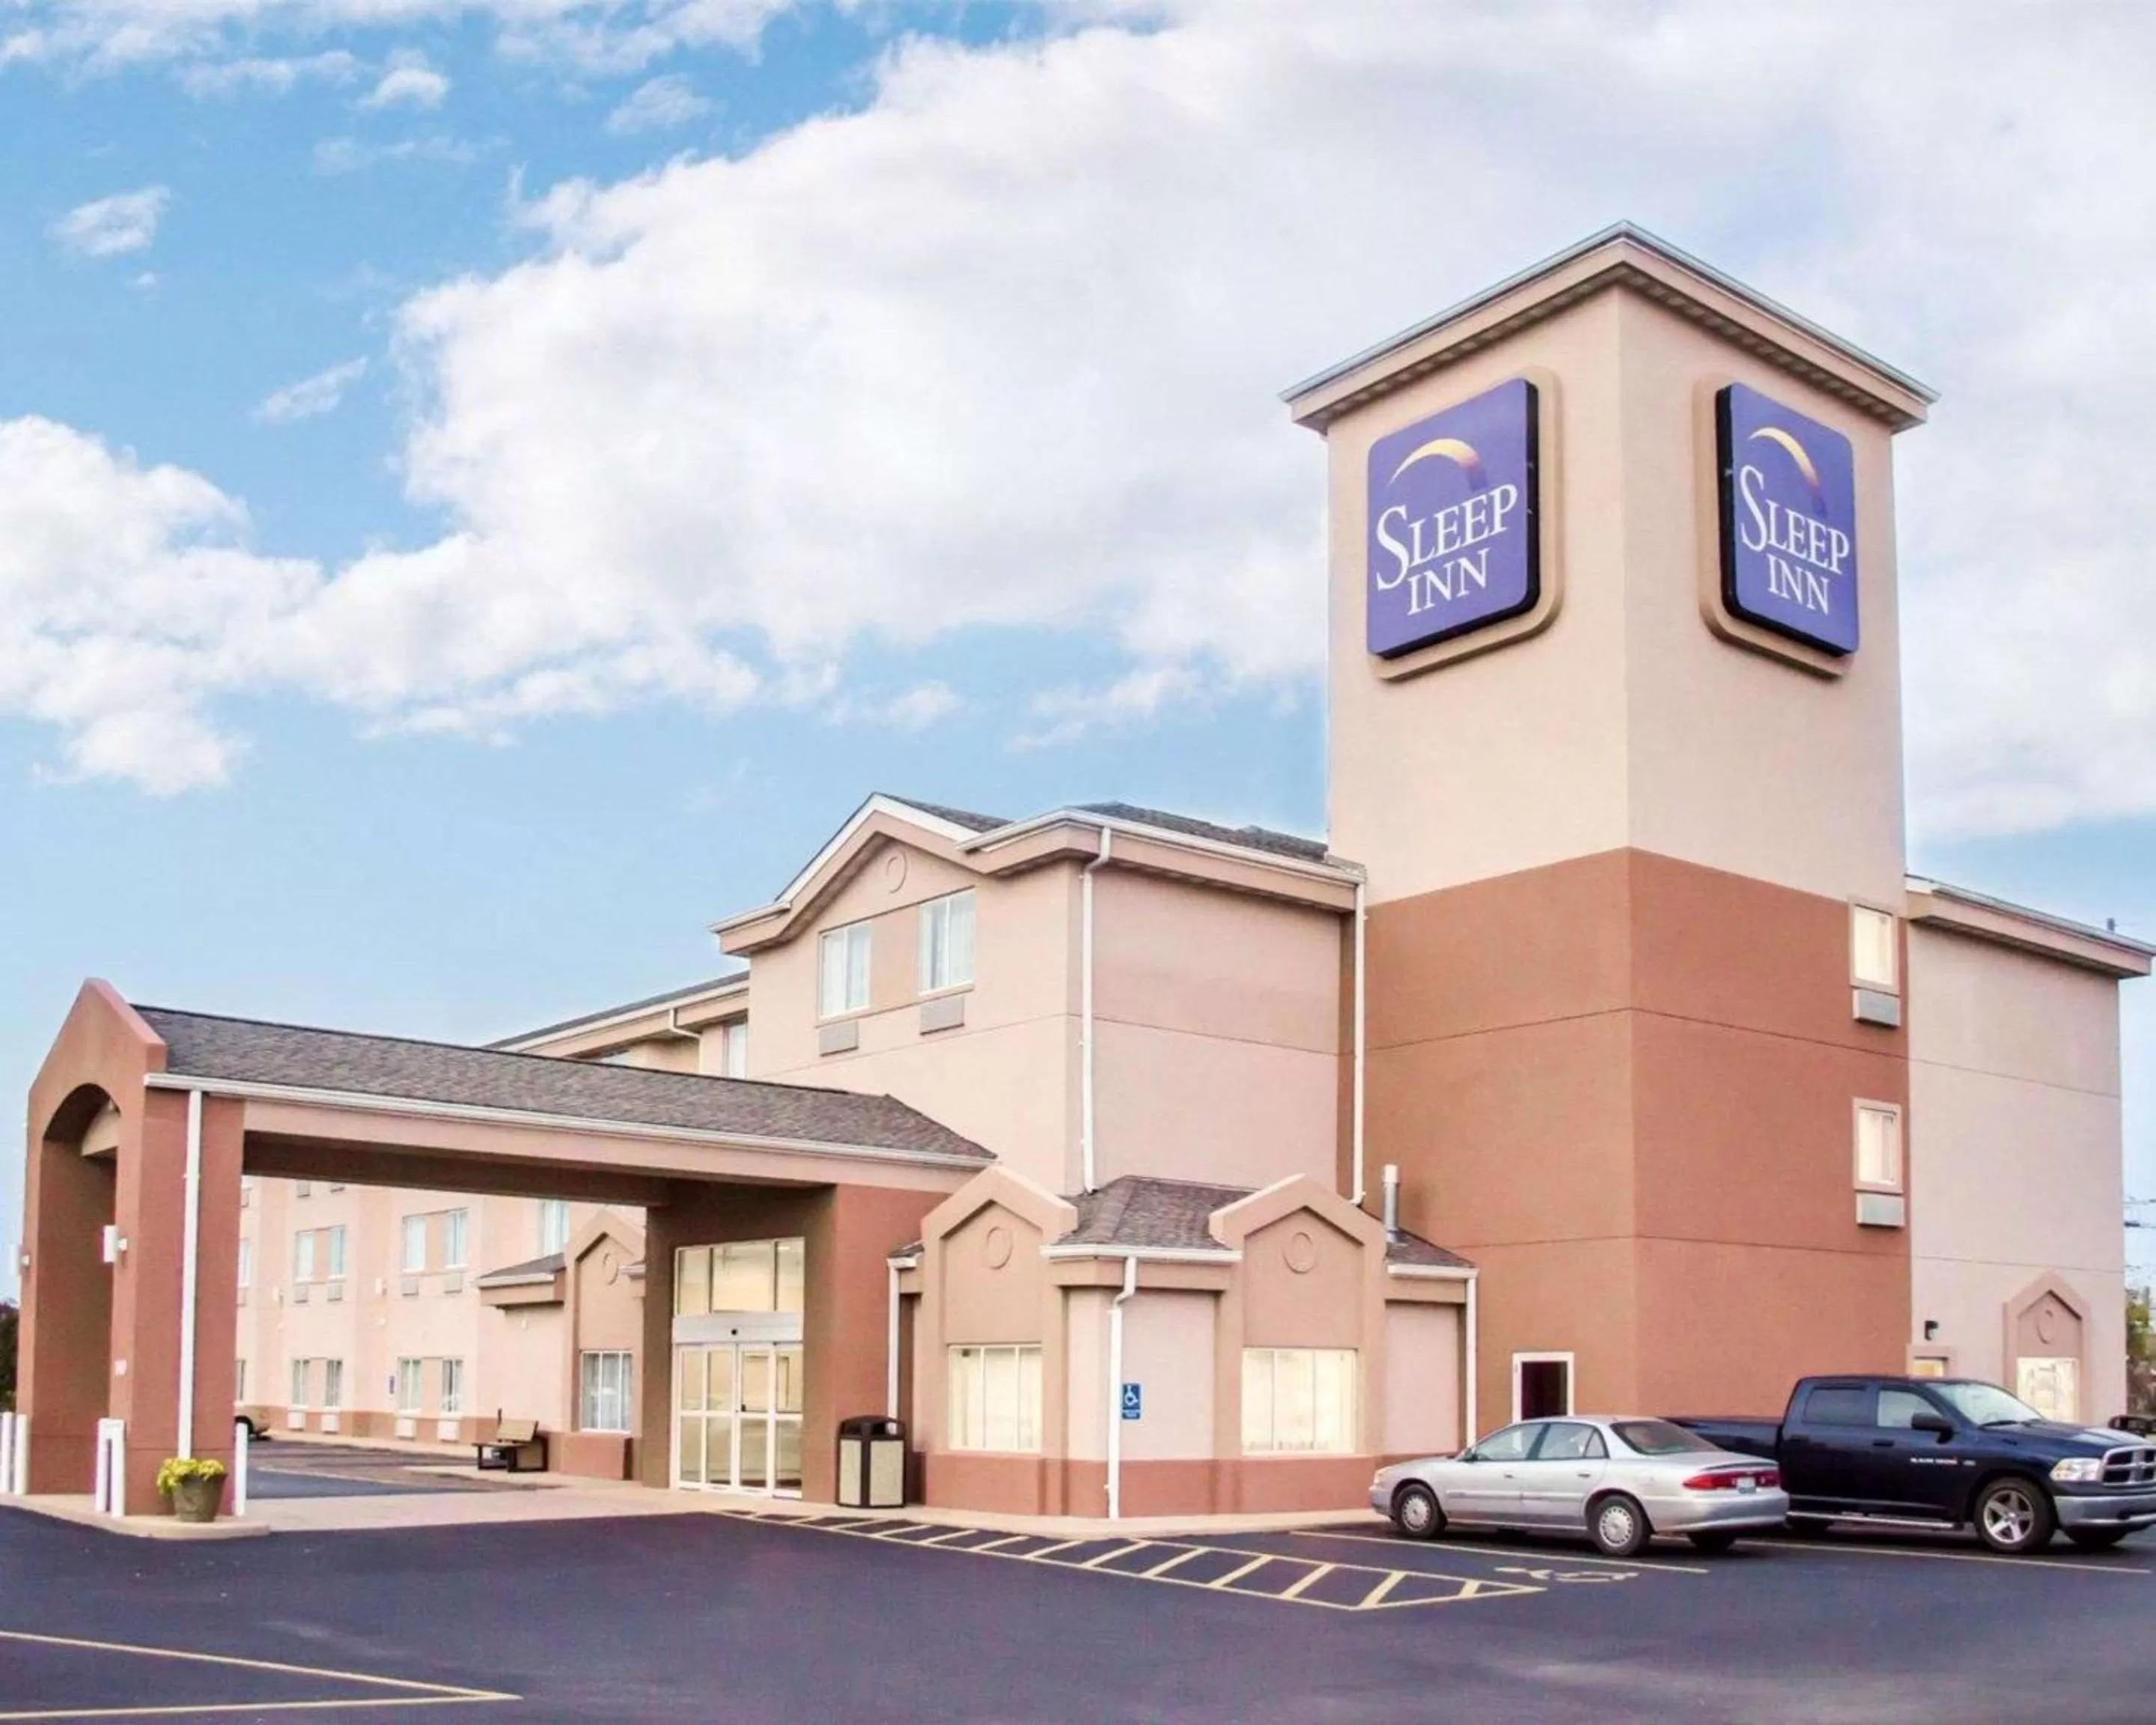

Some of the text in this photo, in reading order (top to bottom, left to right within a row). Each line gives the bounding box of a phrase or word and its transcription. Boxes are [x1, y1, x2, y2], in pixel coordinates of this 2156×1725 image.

[1376, 484, 1518, 591] SLEEP
[1740, 465, 1850, 575] SLEEP
[1407, 548, 1490, 615] INN
[1767, 553, 1830, 615] INN
